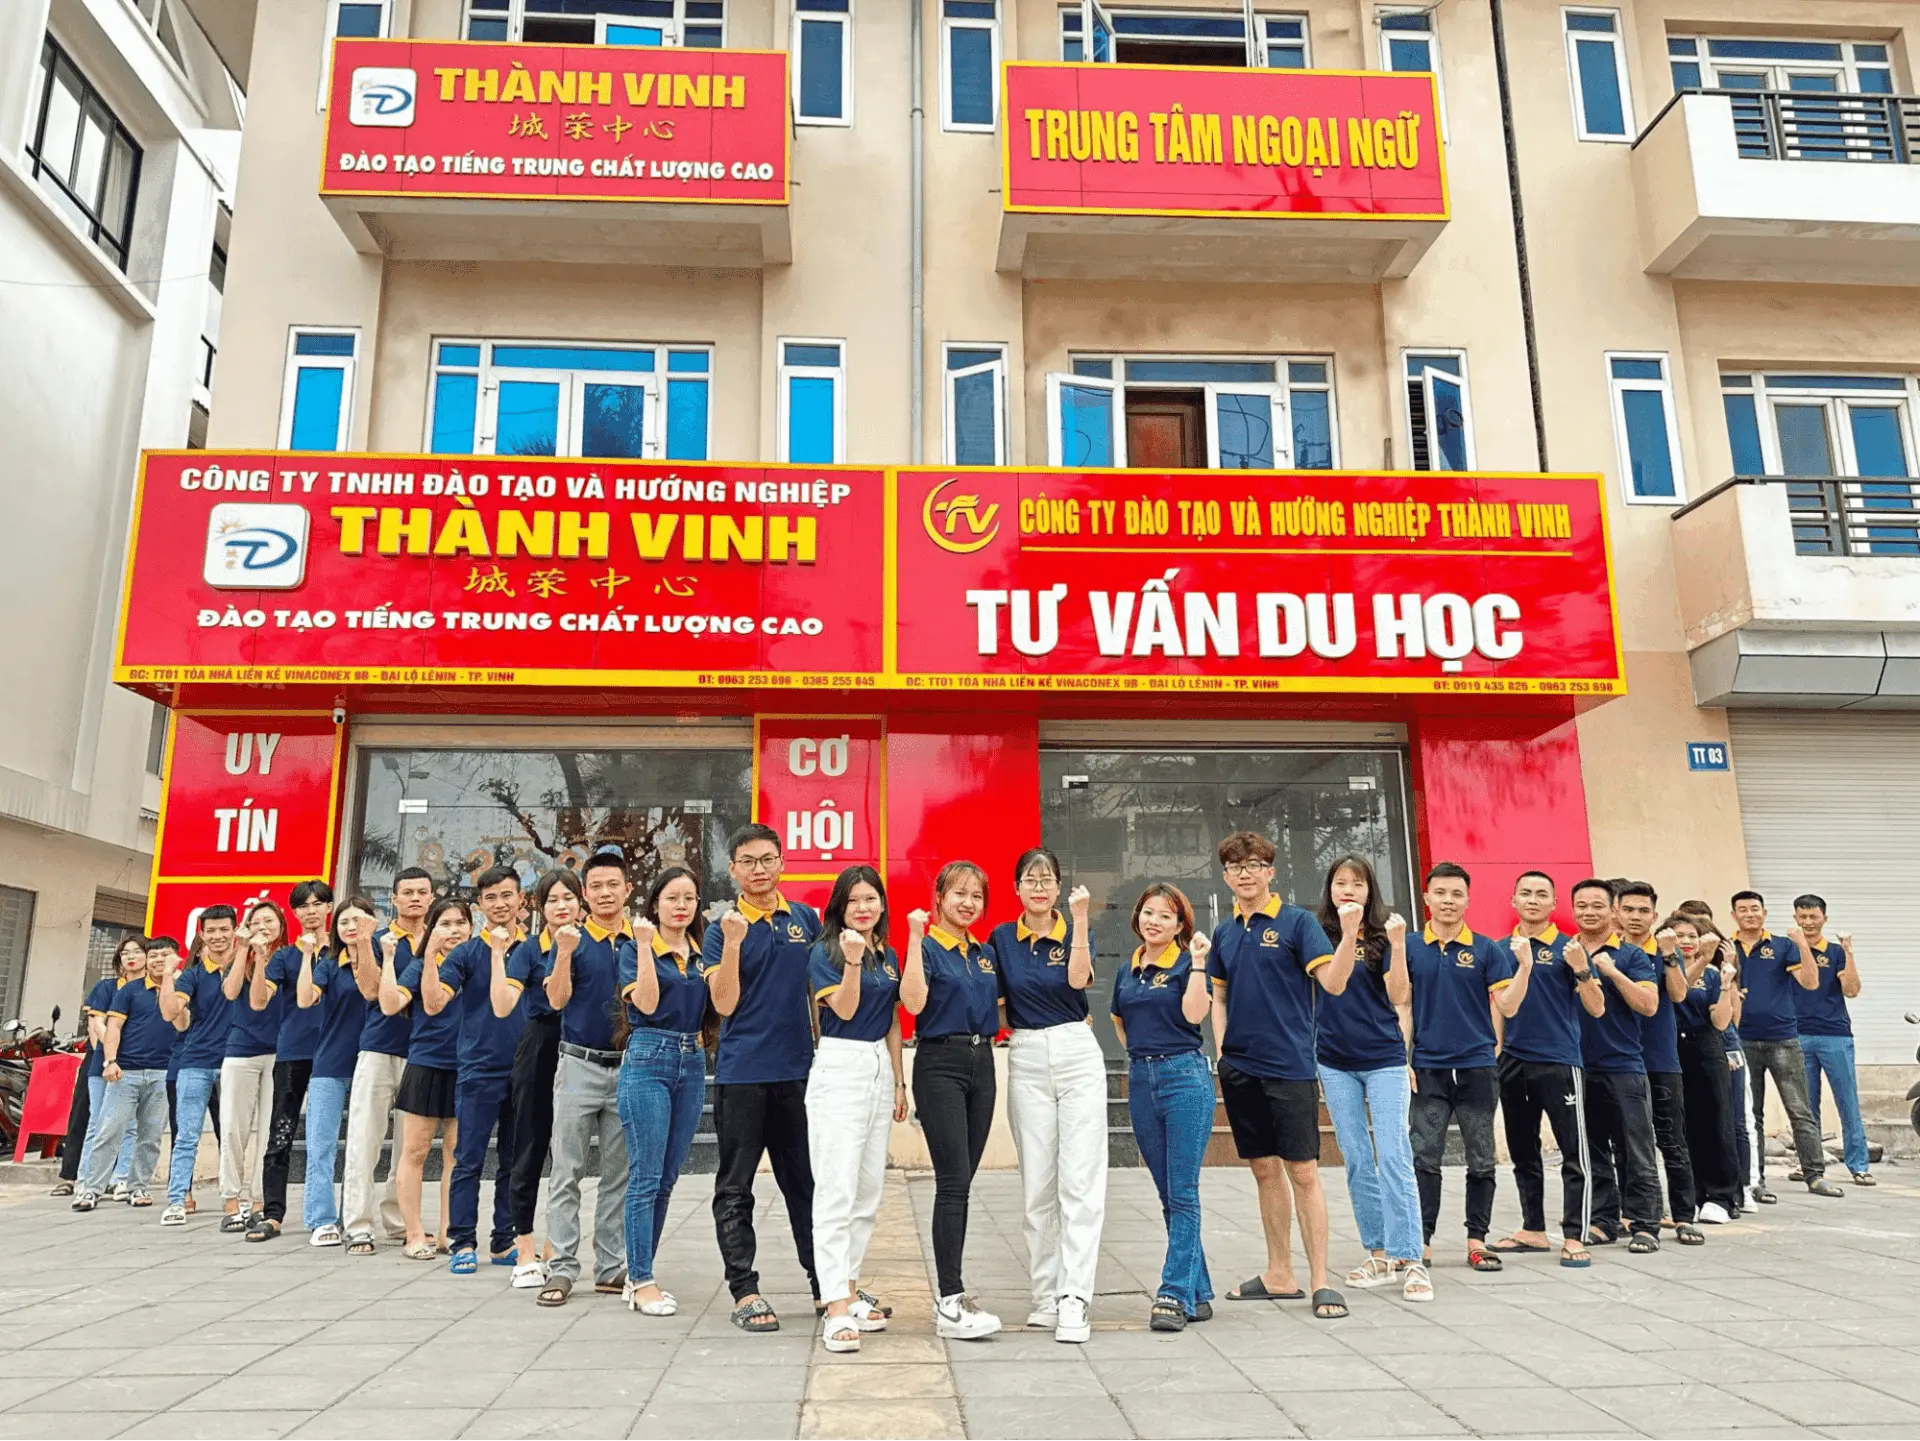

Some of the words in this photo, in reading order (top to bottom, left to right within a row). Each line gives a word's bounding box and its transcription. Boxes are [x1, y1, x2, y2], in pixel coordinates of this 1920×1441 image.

[434, 61, 612, 104] THÀNH
[624, 73, 745, 107] VINH
[1025, 109, 1139, 161] TRUNG
[1149, 102, 1223, 163] TÂM
[1232, 115, 1340, 176] NGOẠI
[1348, 110, 1420, 168] NGỮ
[340, 150, 387, 171] ĐÀO
[393, 155, 435, 176] TẠO
[442, 150, 505, 174] TIẾNG
[512, 158, 584, 176] TRUNG
[591, 154, 645, 177] CHẤT
[651, 161, 725, 182] LƯỢNG
[731, 162, 773, 180] CAO
[181, 465, 269, 491] CÔNG
[280, 471, 318, 492] TY
[328, 472, 414, 494] TNHH
[423, 469, 488, 495] ĐÀO
[498, 476, 556, 501] TẠO
[567, 474, 604, 498] VÀ
[616, 474, 725, 501] HƯỚNG
[735, 479, 850, 507] NGHIỆP
[331, 495, 609, 557] THÀNH
[631, 513, 816, 560] VINH
[1020, 492, 1079, 533] CÔNG
[1088, 501, 1115, 534] TY
[1125, 496, 1168, 534] ĐÀO
[1178, 501, 1220, 540] TẠO
[1230, 496, 1261, 535] VÀ
[1270, 496, 1345, 536] HƯỚNG
[1353, 497, 1430, 542] NGHIỆP
[1437, 498, 1511, 537] THÀNH
[1517, 504, 1571, 537] VINH
[197, 605, 266, 627] ĐÀO
[274, 610, 336, 632] TẠO
[345, 602, 435, 628] TIẾNG
[443, 612, 551, 630] TRUNG
[560, 606, 638, 631] CHẤT
[645, 616, 754, 638] LƯỢNG
[762, 617, 823, 635] CAO
[966, 584, 1067, 654] TƯ
[1089, 568, 1239, 656] VẤN
[1257, 593, 1356, 657] DU
[1373, 593, 1523, 671] HỌC
[285, 670, 351, 681] VINACONEX
[487, 671, 514, 682] VINH
[747, 675, 768, 686] 253
[832, 676, 852, 687] 255
[1055, 678, 1120, 689] VINACONEX
[1252, 680, 1280, 690] VINH
[1483, 681, 1505, 691] 435
[1569, 682, 1590, 692] 253
[225, 733, 281, 775] UY
[788, 735, 850, 777] CƠ
[1708, 747, 1724, 764] 03
[214, 798, 278, 852] TÍN
[787, 799, 854, 860] HỘI
